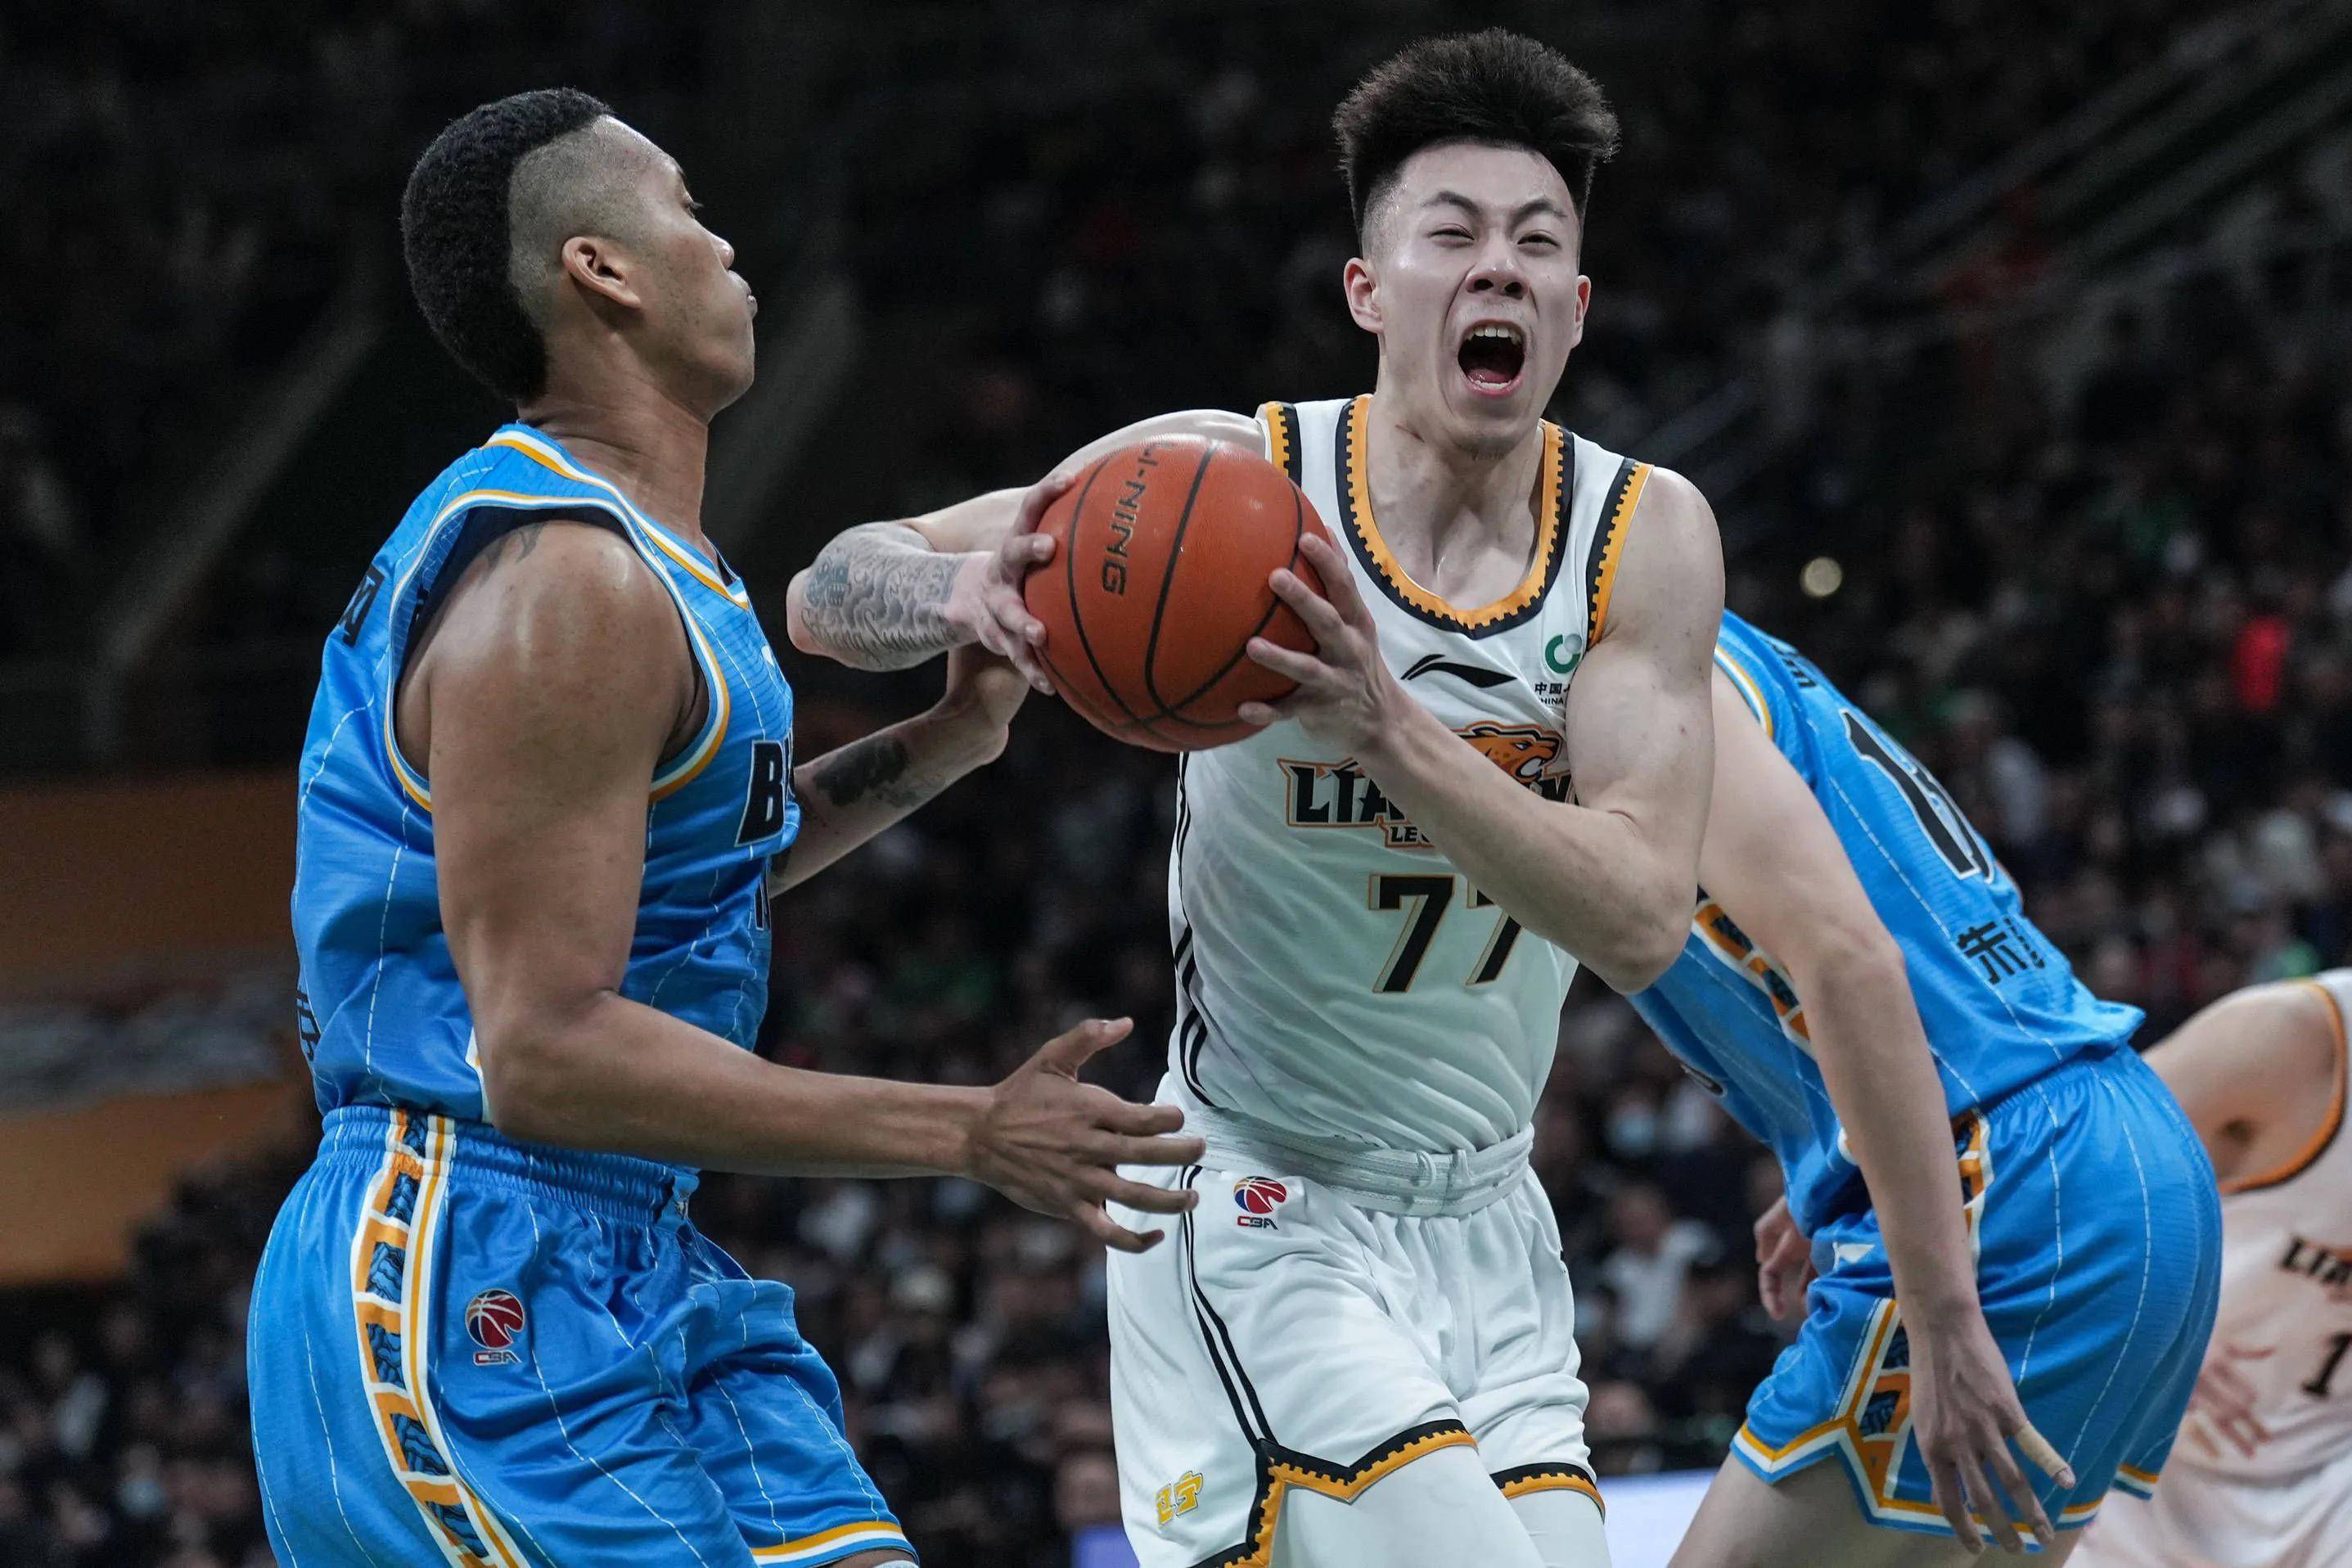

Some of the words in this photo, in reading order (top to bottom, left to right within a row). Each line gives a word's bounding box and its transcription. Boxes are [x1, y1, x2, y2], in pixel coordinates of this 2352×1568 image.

[1368, 874, 1525, 994] 77
[1237, 1215, 1278, 1230] CBA
[473, 1349, 522, 1366] CBA
